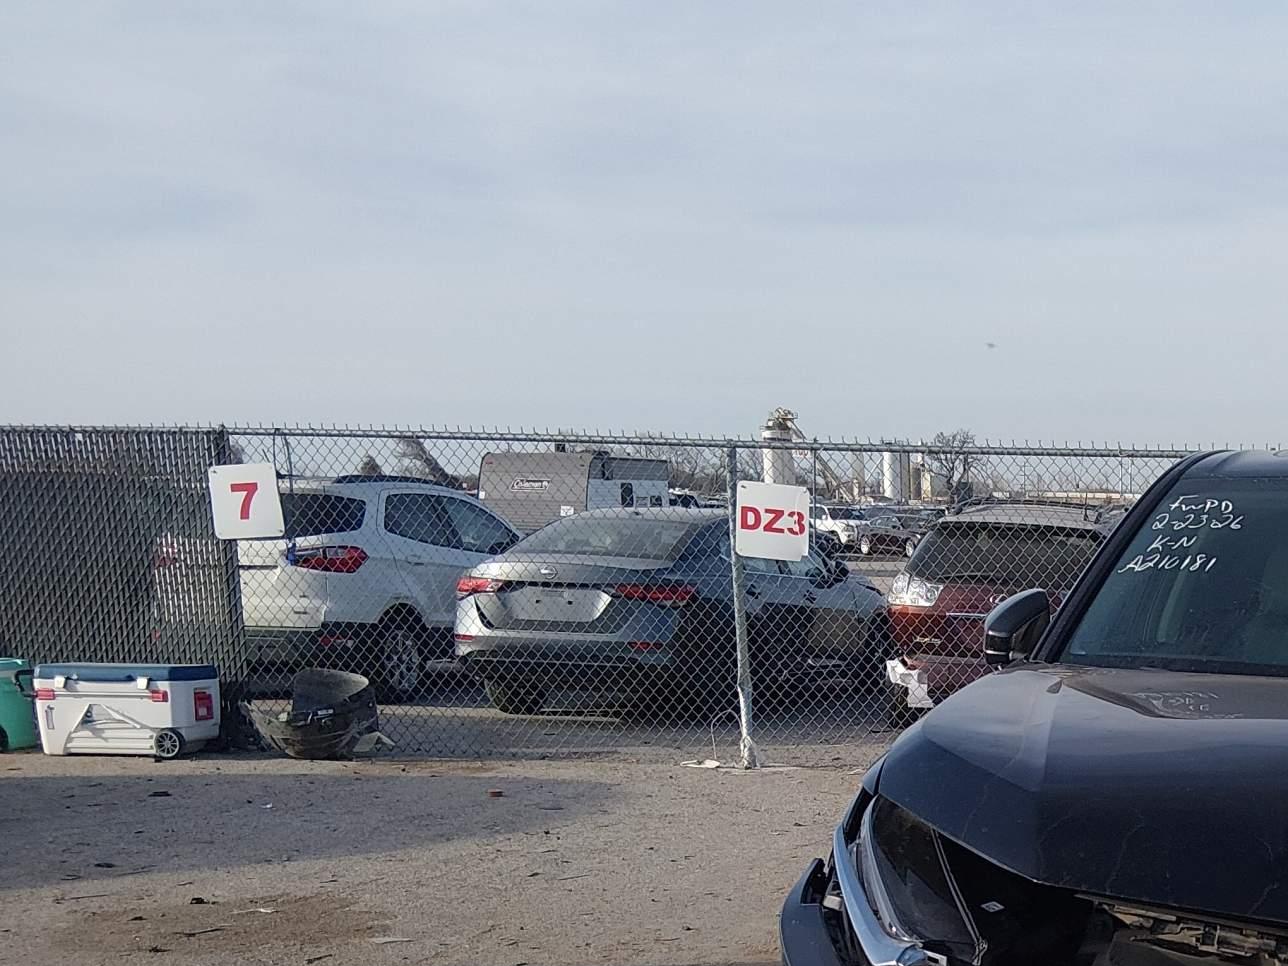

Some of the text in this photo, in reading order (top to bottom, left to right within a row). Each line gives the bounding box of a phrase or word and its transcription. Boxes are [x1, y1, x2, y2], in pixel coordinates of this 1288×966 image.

[229, 482, 258, 520] 7
[740, 506, 806, 536] DZ3
[1117, 553, 1217, 573] A210181
